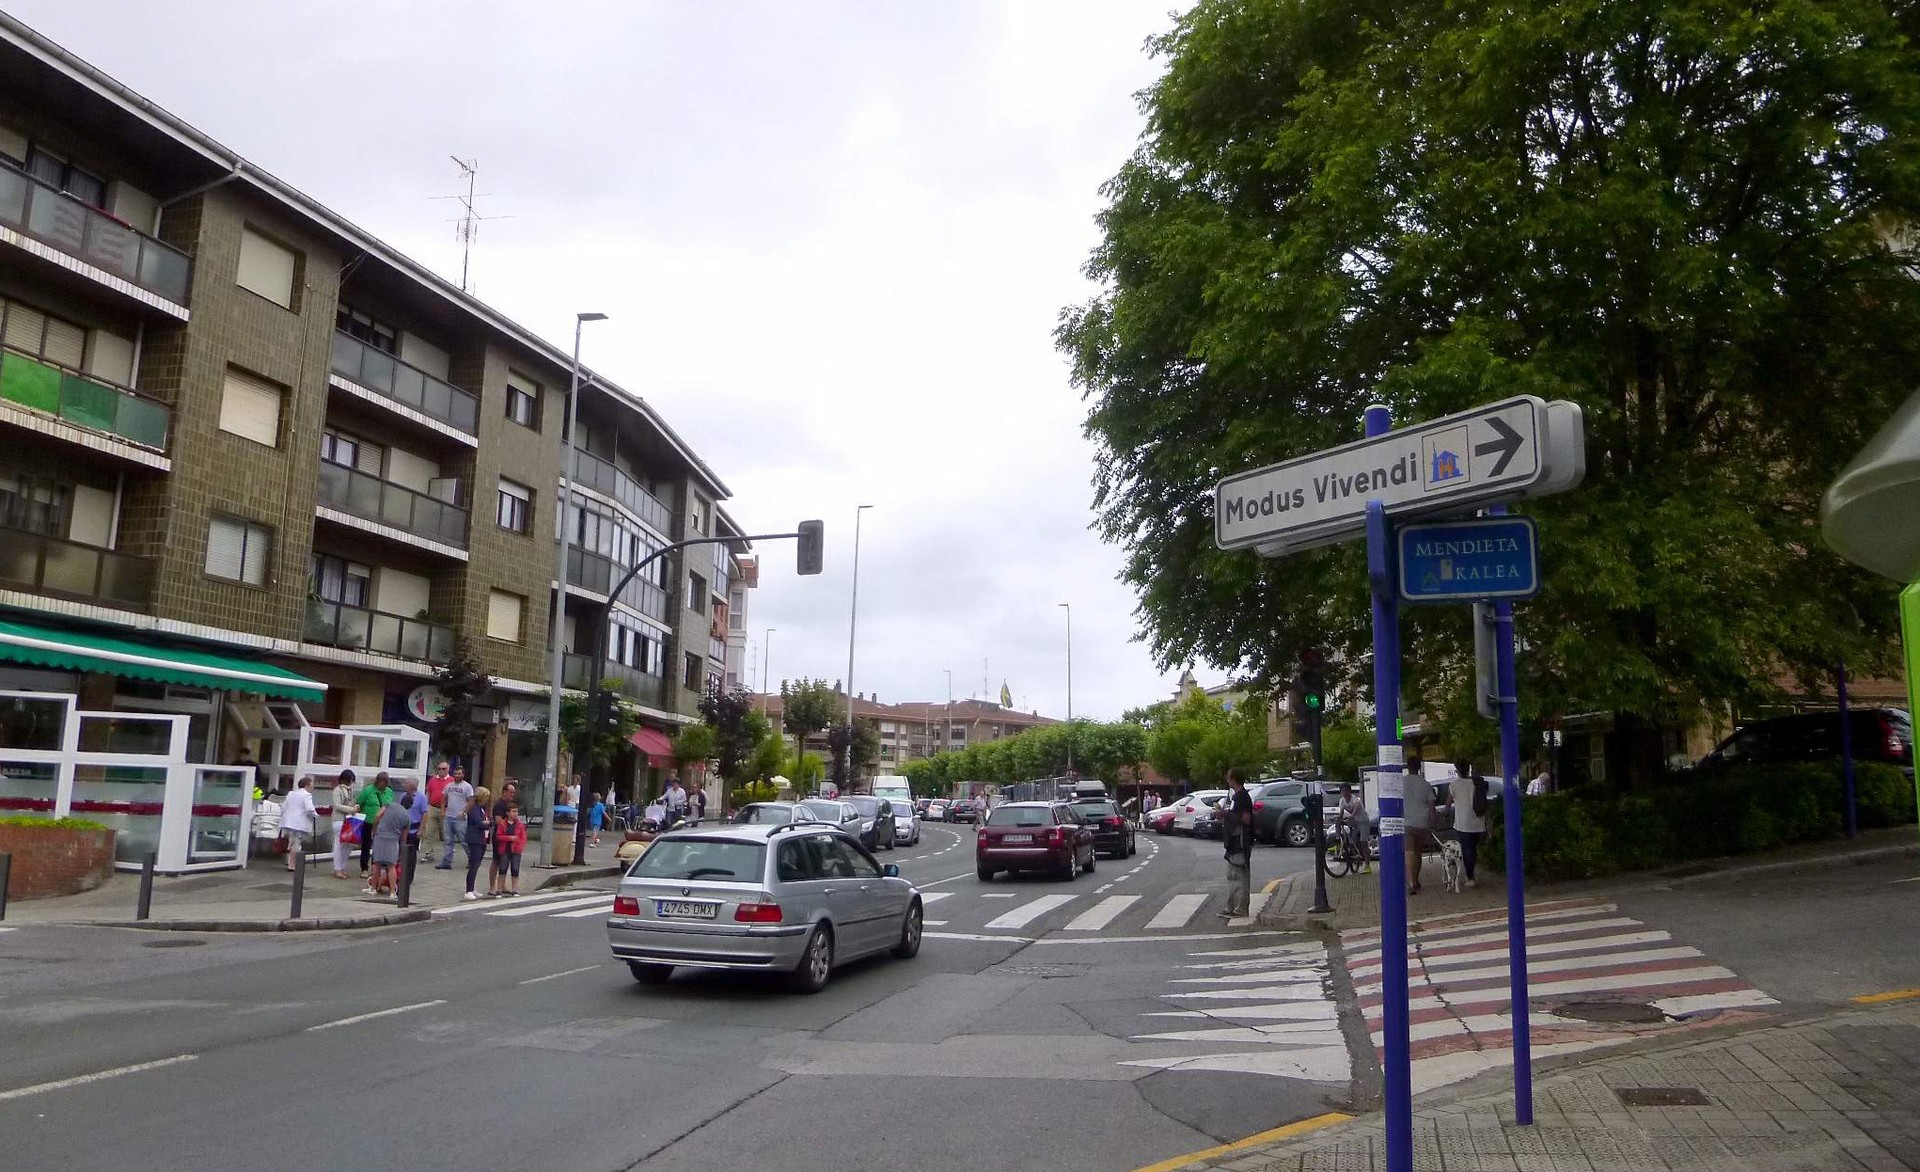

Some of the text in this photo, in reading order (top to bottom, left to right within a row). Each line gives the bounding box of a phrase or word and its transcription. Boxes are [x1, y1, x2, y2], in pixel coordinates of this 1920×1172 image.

[1225, 452, 1418, 525] Modus Vivendi
[1415, 538, 1520, 557] MENDIETA
[1455, 564, 1520, 580] KALEA
[664, 902, 690, 914] 4745
